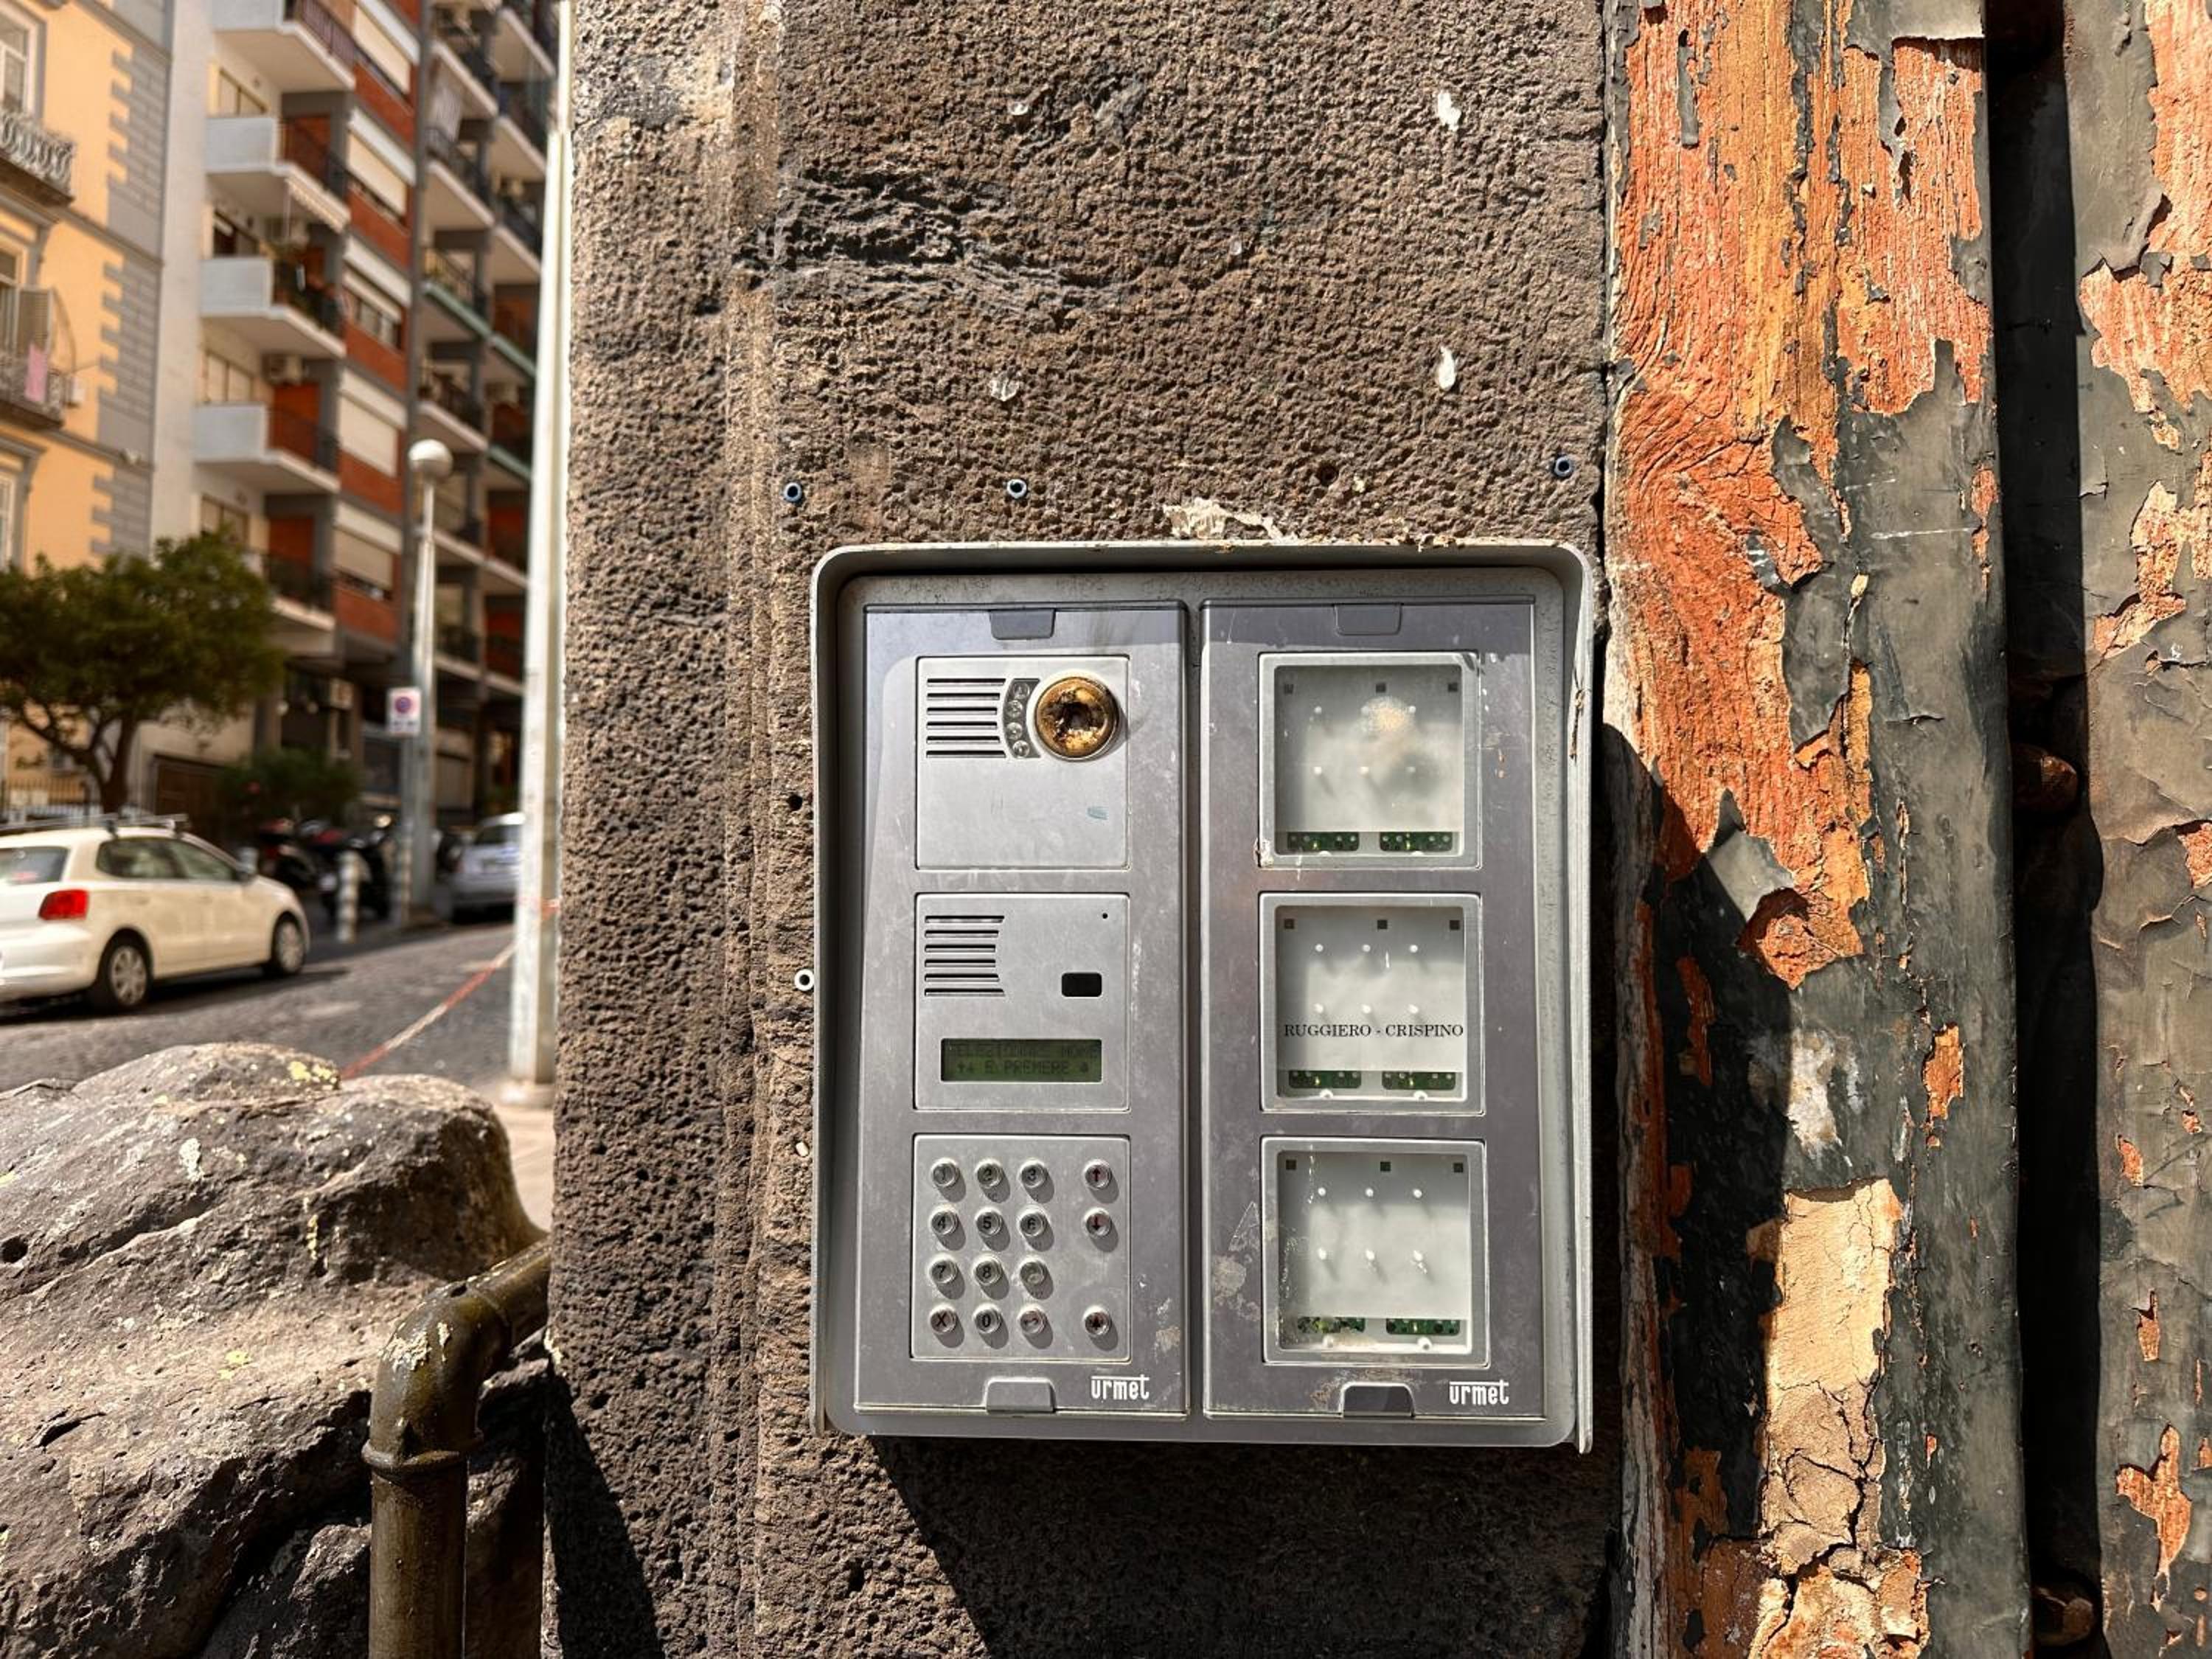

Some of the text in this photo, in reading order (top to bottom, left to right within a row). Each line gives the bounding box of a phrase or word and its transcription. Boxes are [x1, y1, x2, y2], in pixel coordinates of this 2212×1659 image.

[1284, 1024, 1371, 1037] RUGGIERO
[1385, 1024, 1464, 1037] CRISPINO
[982, 1216, 992, 1229] 5
[982, 1264, 992, 1279] 8
[1091, 1374, 1150, 1399] urmet
[1449, 1380, 1509, 1405] urmet
